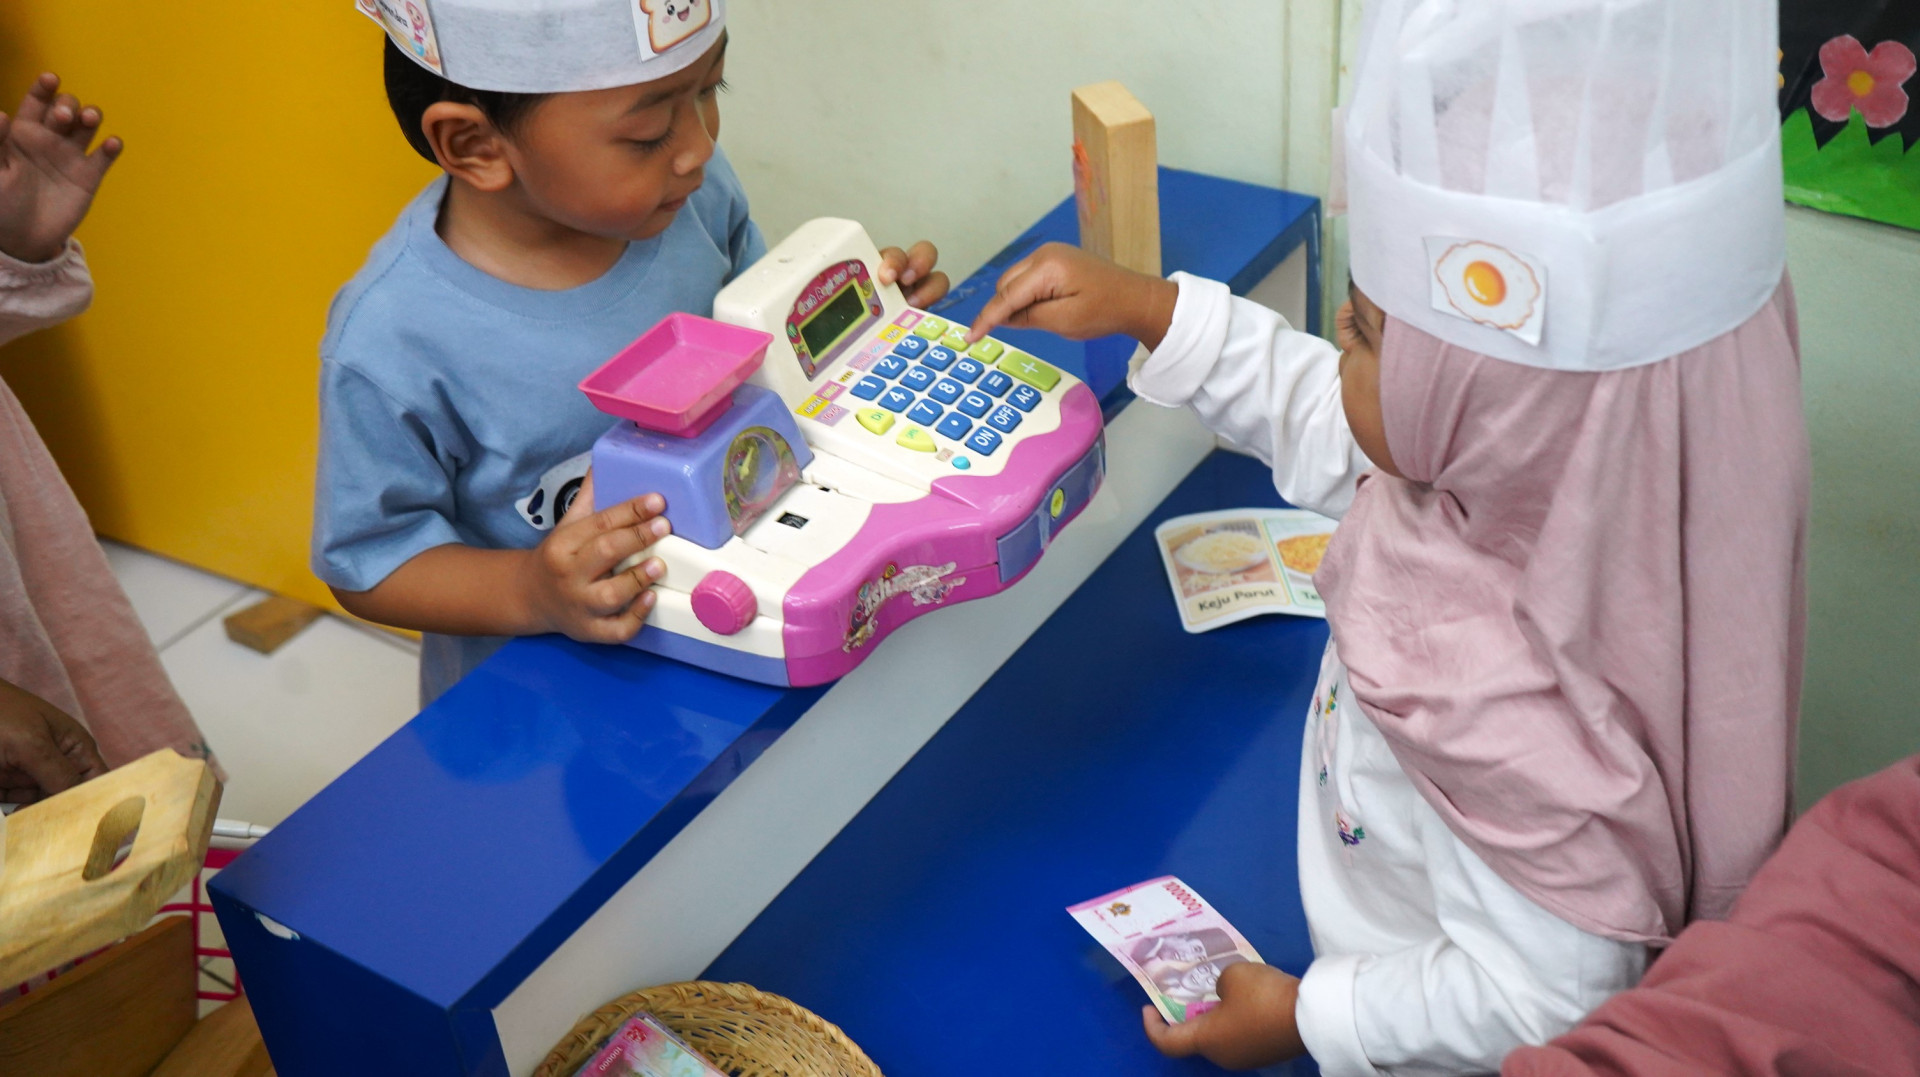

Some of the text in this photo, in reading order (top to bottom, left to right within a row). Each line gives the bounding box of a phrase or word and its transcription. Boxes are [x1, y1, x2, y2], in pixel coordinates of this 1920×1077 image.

[859, 380, 877, 389] 1
[879, 358, 900, 370] 2
[901, 338, 920, 350] 3
[888, 390, 907, 403] 4
[908, 369, 928, 381] 5
[929, 349, 948, 361] 6
[914, 401, 935, 415] 7
[937, 382, 957, 395] 8
[957, 361, 977, 374] 9
[966, 395, 985, 408] 0
[974, 387, 1035, 447] ON OFF AC
[1198, 588, 1275, 611] Keju Parut
